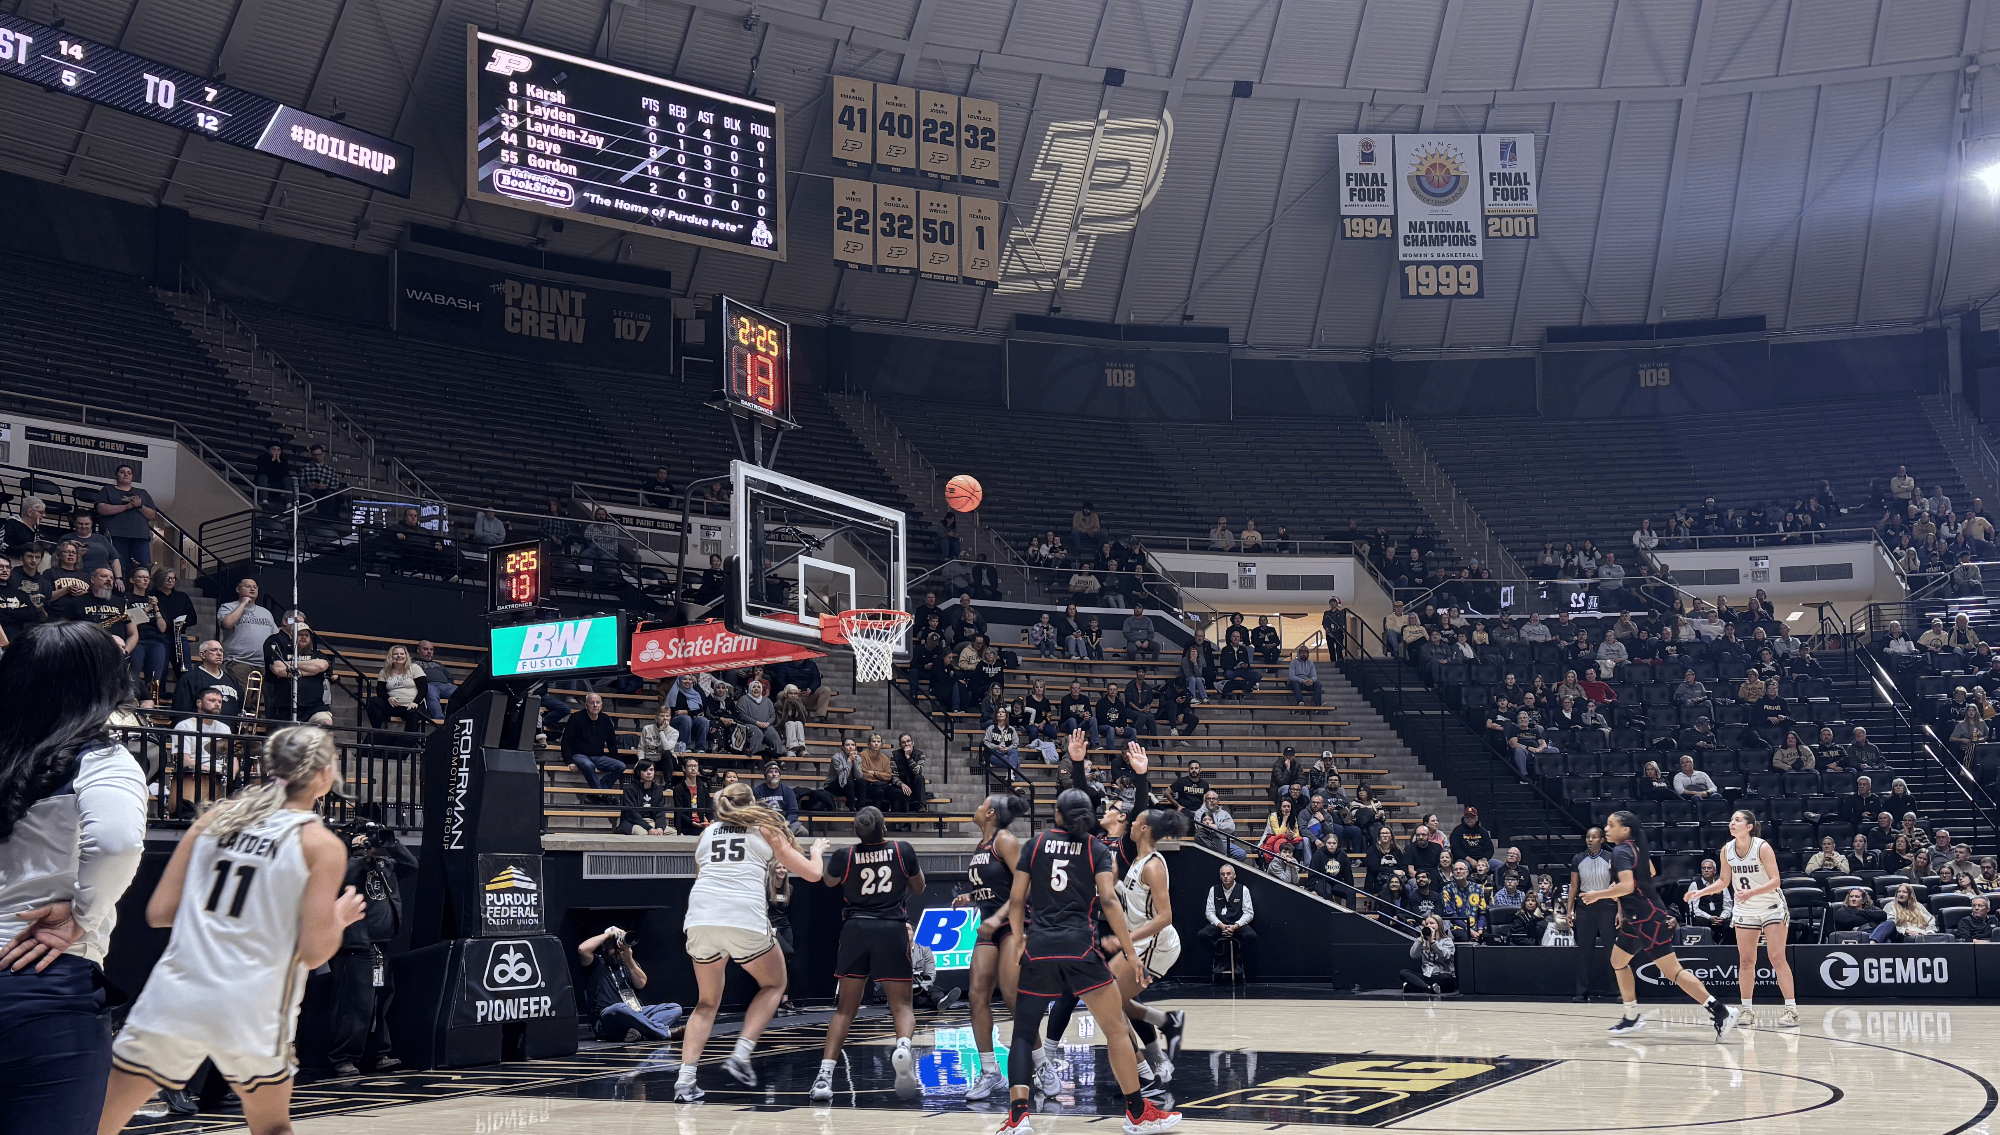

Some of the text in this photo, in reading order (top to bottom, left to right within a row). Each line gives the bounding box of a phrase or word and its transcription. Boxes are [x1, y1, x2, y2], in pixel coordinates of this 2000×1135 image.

[59, 40, 84, 60] 14
[61, 70, 76, 87] 5
[143, 73, 175, 108] TO
[204, 87, 218, 102] 7
[197, 113, 219, 131] 12
[509, 81, 765, 152] 8 Karsh 6 0 4 0 0
[642, 97, 771, 138] PTS REB AST BLK FOUL
[838, 105, 867, 133] 41
[879, 111, 913, 139] 40
[507, 98, 763, 168] 11 Layden 0 1 0 0 1
[923, 118, 954, 147] 22
[965, 124, 995, 152] 32
[291, 125, 396, 175] #BOILERUP
[501, 113, 765, 183] 33 Layden-Zay 8 0 3 0 0
[500, 131, 766, 199] 44 Daye 14 4 3 1 0
[500, 149, 766, 216] 55 Gordon 2 0 0 0 0
[501, 175, 566, 197] BookStore
[511, 169, 557, 186] University
[1346, 172, 1387, 186] FINAL
[1489, 172, 1530, 186] FINAL
[1349, 188, 1385, 202] FOUR
[1493, 187, 1529, 201] FOUR
[614, 199, 649, 214] Home
[652, 208, 666, 218] of
[668, 210, 708, 227] Purdue
[837, 206, 869, 235] 22
[880, 212, 913, 240] 32
[923, 217, 954, 245] 50
[976, 225, 984, 250] 1
[1343, 218, 1392, 238] 1994
[1408, 221, 1471, 234] NATIONAL
[1488, 217, 1535, 237] 2001
[1403, 234, 1477, 247] CHAMPIONS
[1405, 265, 1478, 296] 1999
[406, 288, 480, 312] WABASH
[504, 278, 586, 317] PAINT
[504, 307, 586, 343] CREW
[613, 309, 652, 321] SECTION
[614, 318, 651, 342] 107
[739, 316, 778, 357] 2:25
[746, 353, 774, 406] 13
[1105, 368, 1136, 388] 108
[1638, 367, 1670, 388] 109
[741, 399, 773, 416] DAKTRONICS
[50, 432, 125, 452] THE PAINT CREW
[622, 516, 676, 530] THE PAINT CREW
[705, 530, 716, 538] 6-7
[507, 550, 537, 573] 2:25
[511, 574, 530, 600] 13
[497, 601, 533, 611] DAKTRONICS
[520, 620, 592, 659] BW
[521, 656, 574, 670] FUSION
[442, 724, 461, 850] AUTOMOTIVE GROUP
[449, 719, 474, 850] ROHRMAN
[711, 838, 746, 863] 55
[1044, 839, 1083, 856] COTTON
[860, 865, 893, 896] 22
[1050, 858, 1070, 892] 5
[1731, 864, 1760, 874] URDUE
[205, 859, 257, 919] 11
[1740, 877, 1752, 889] 8
[485, 893, 538, 906] PURDUE
[486, 906, 539, 918] FEDERAL
[487, 918, 514, 926] CREDIT
[1864, 957, 1948, 984] GEMCO
[475, 995, 552, 1023] PIONEER
